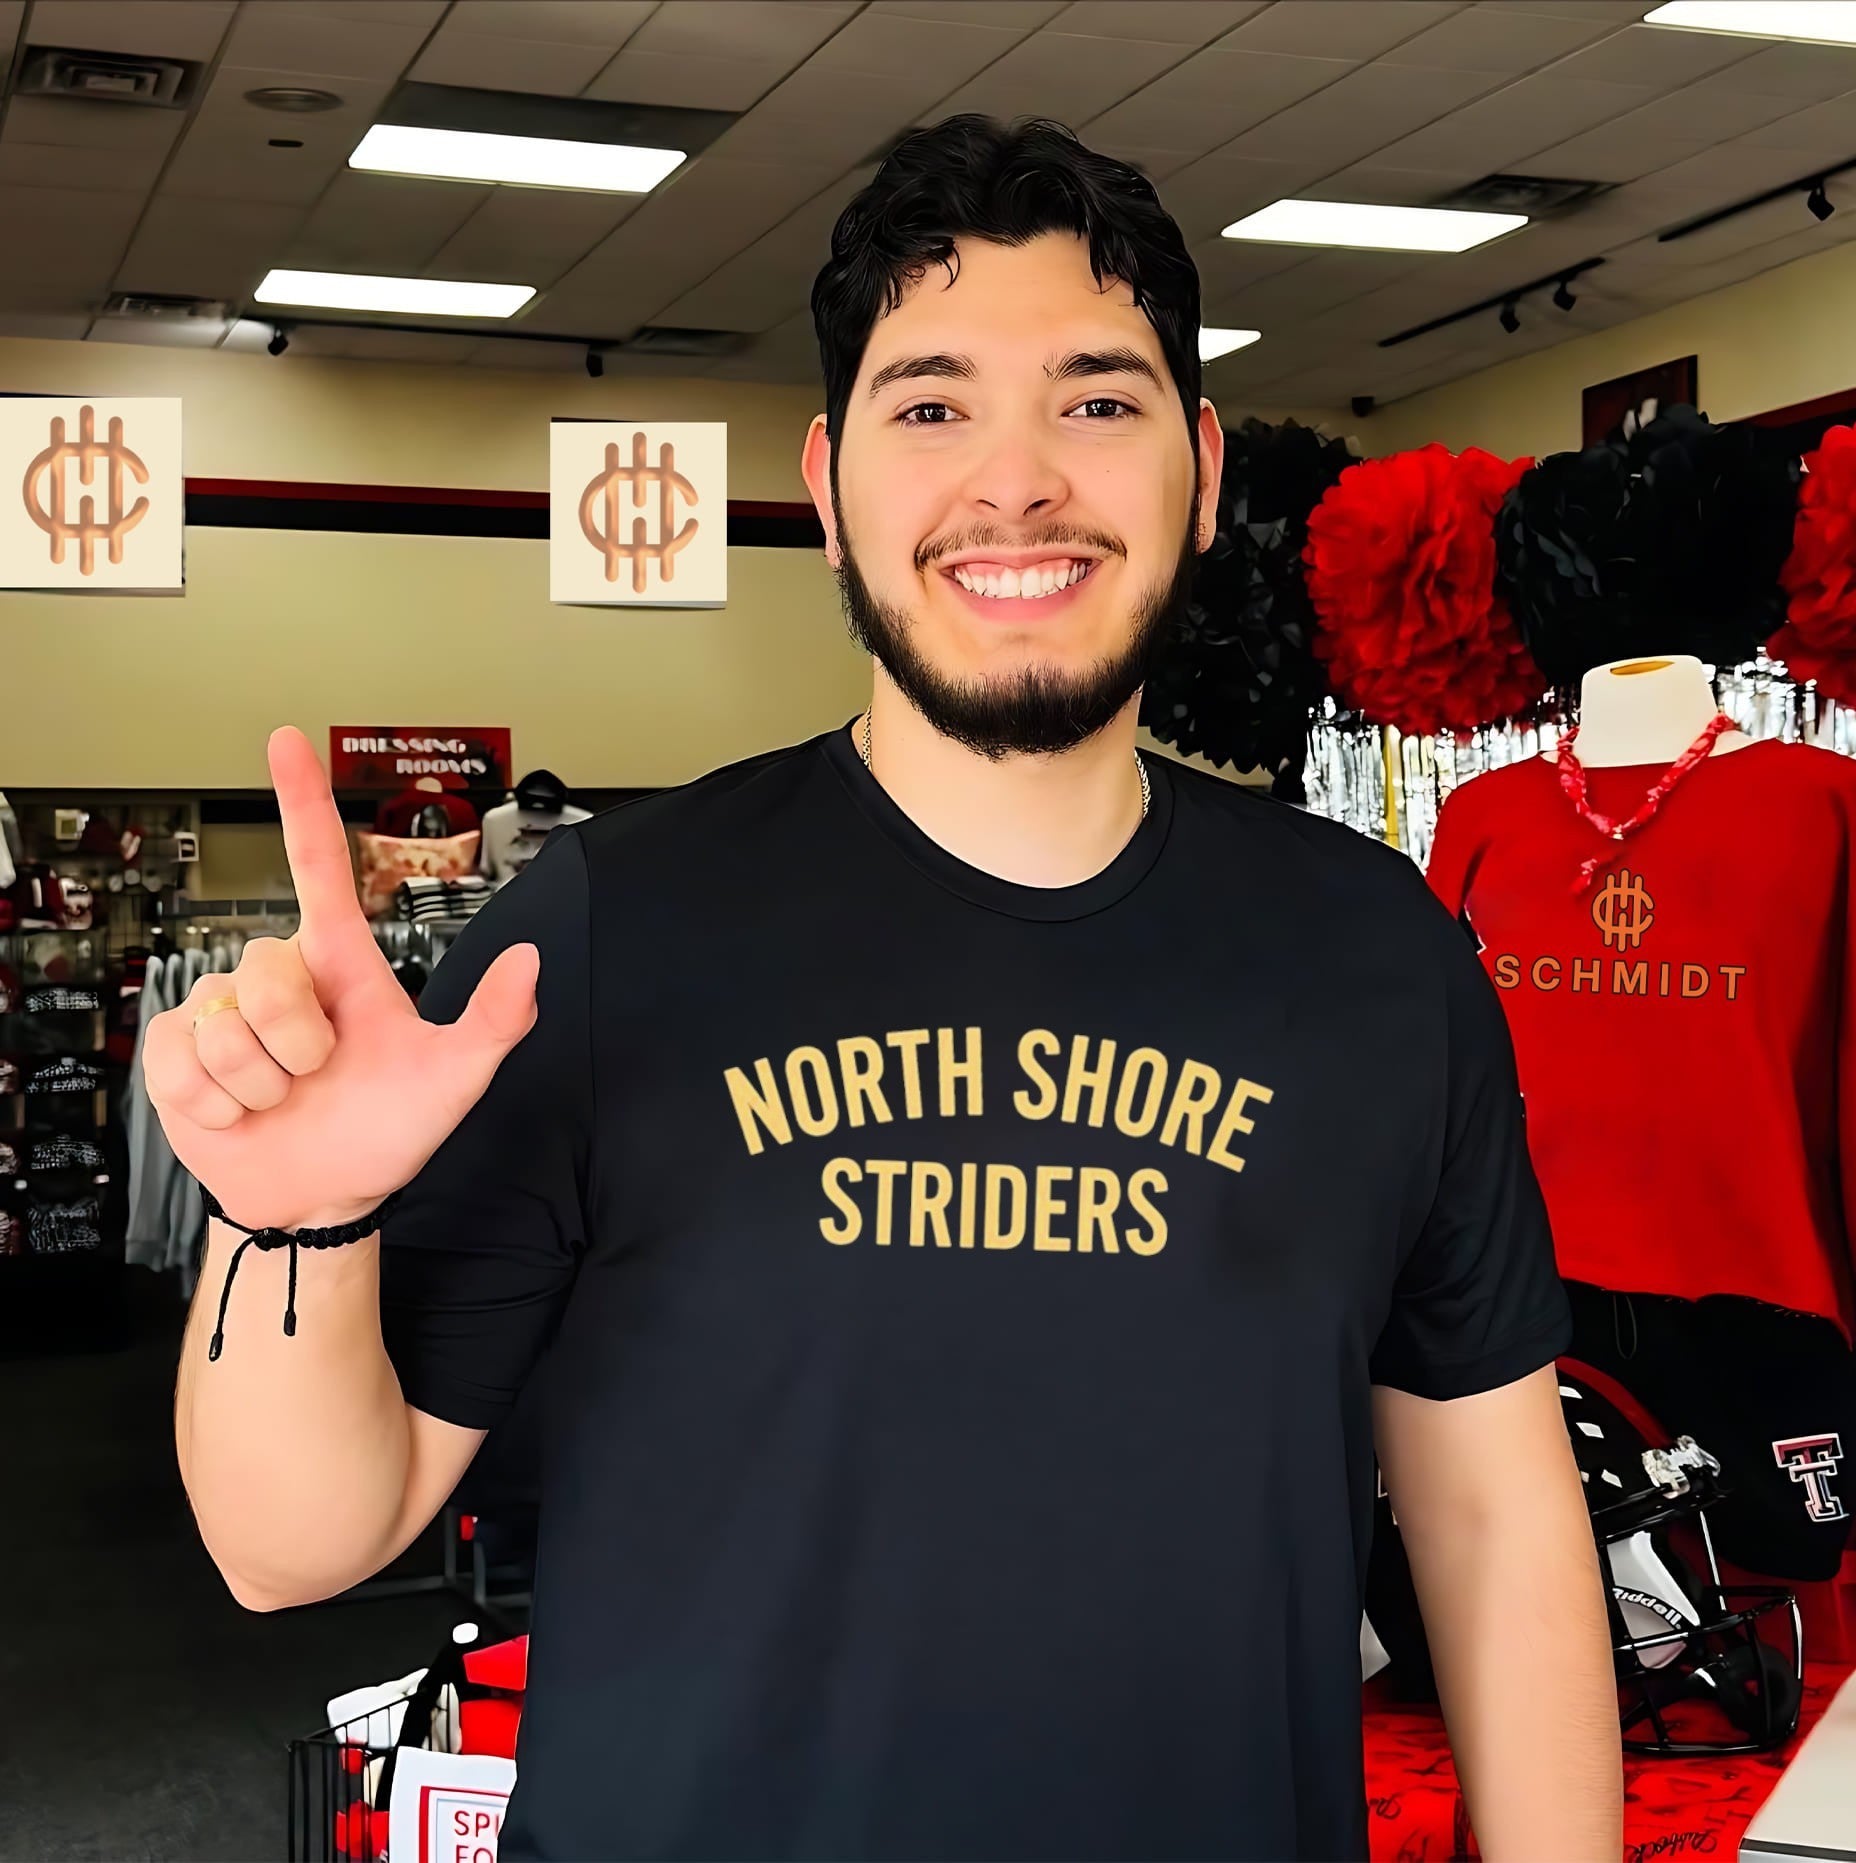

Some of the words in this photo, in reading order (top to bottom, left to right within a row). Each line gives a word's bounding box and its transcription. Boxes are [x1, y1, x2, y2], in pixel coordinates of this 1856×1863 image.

[396, 758, 487, 775] ROOMS
[1493, 953, 1747, 1001] SCHMIDT
[723, 1026, 984, 1157] NORTH
[1012, 1028, 1274, 1174] SHORE
[818, 1156, 1170, 1257] STRIDERS
